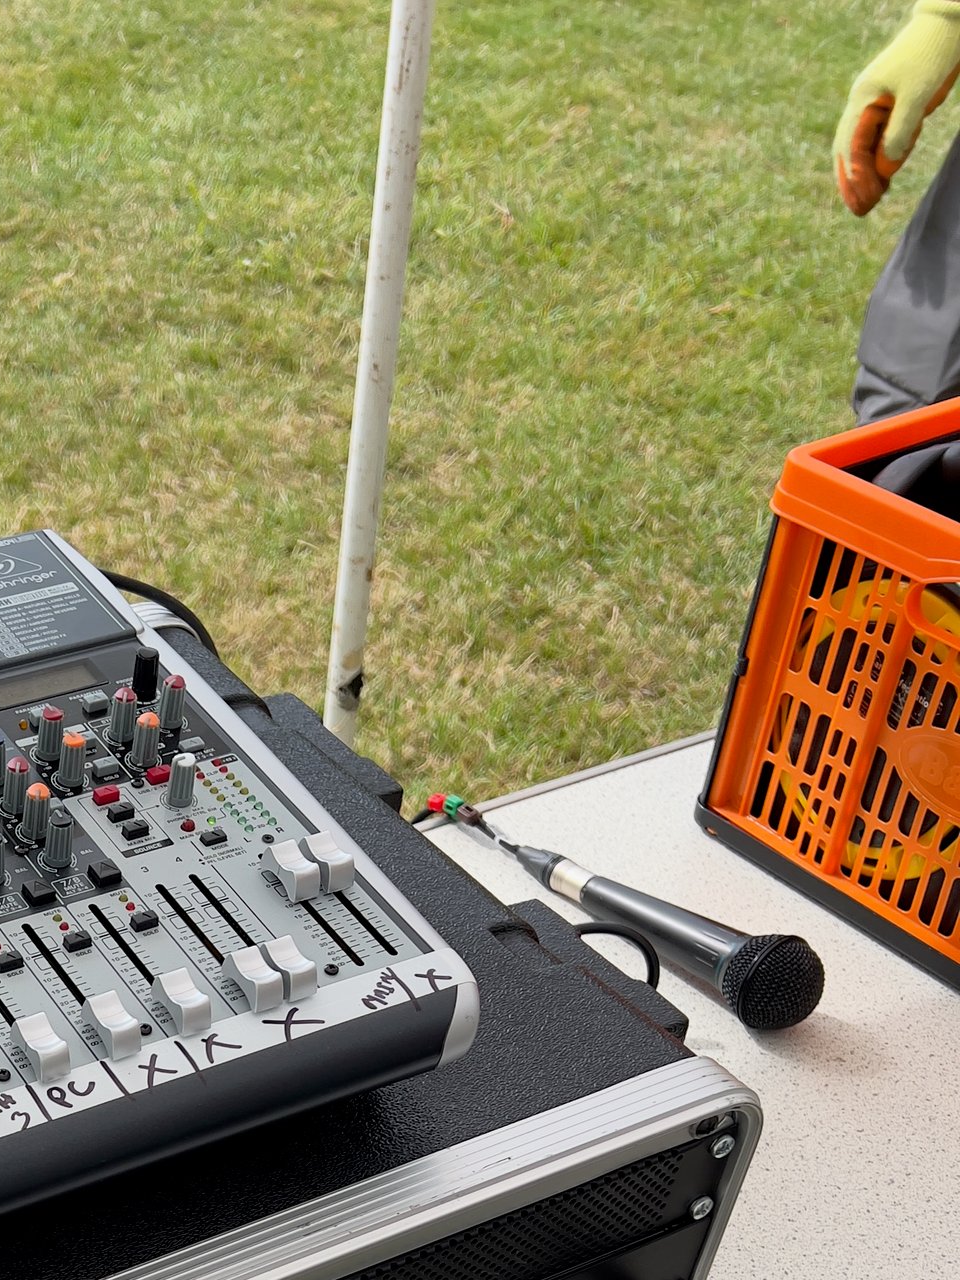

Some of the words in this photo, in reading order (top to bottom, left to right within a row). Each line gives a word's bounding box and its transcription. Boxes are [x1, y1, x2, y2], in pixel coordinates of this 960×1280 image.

[134, 843, 163, 854] SOURCE
[60, 877, 81, 886] 7/8
[63, 882, 84, 891] MUTE
[110, 890, 128, 898] MUTE
[142, 929, 159, 937] SOLO
[7, 970, 24, 978] SOLO
[46, 1080, 96, 1108] PC
[10, 1111, 30, 1131] 3
